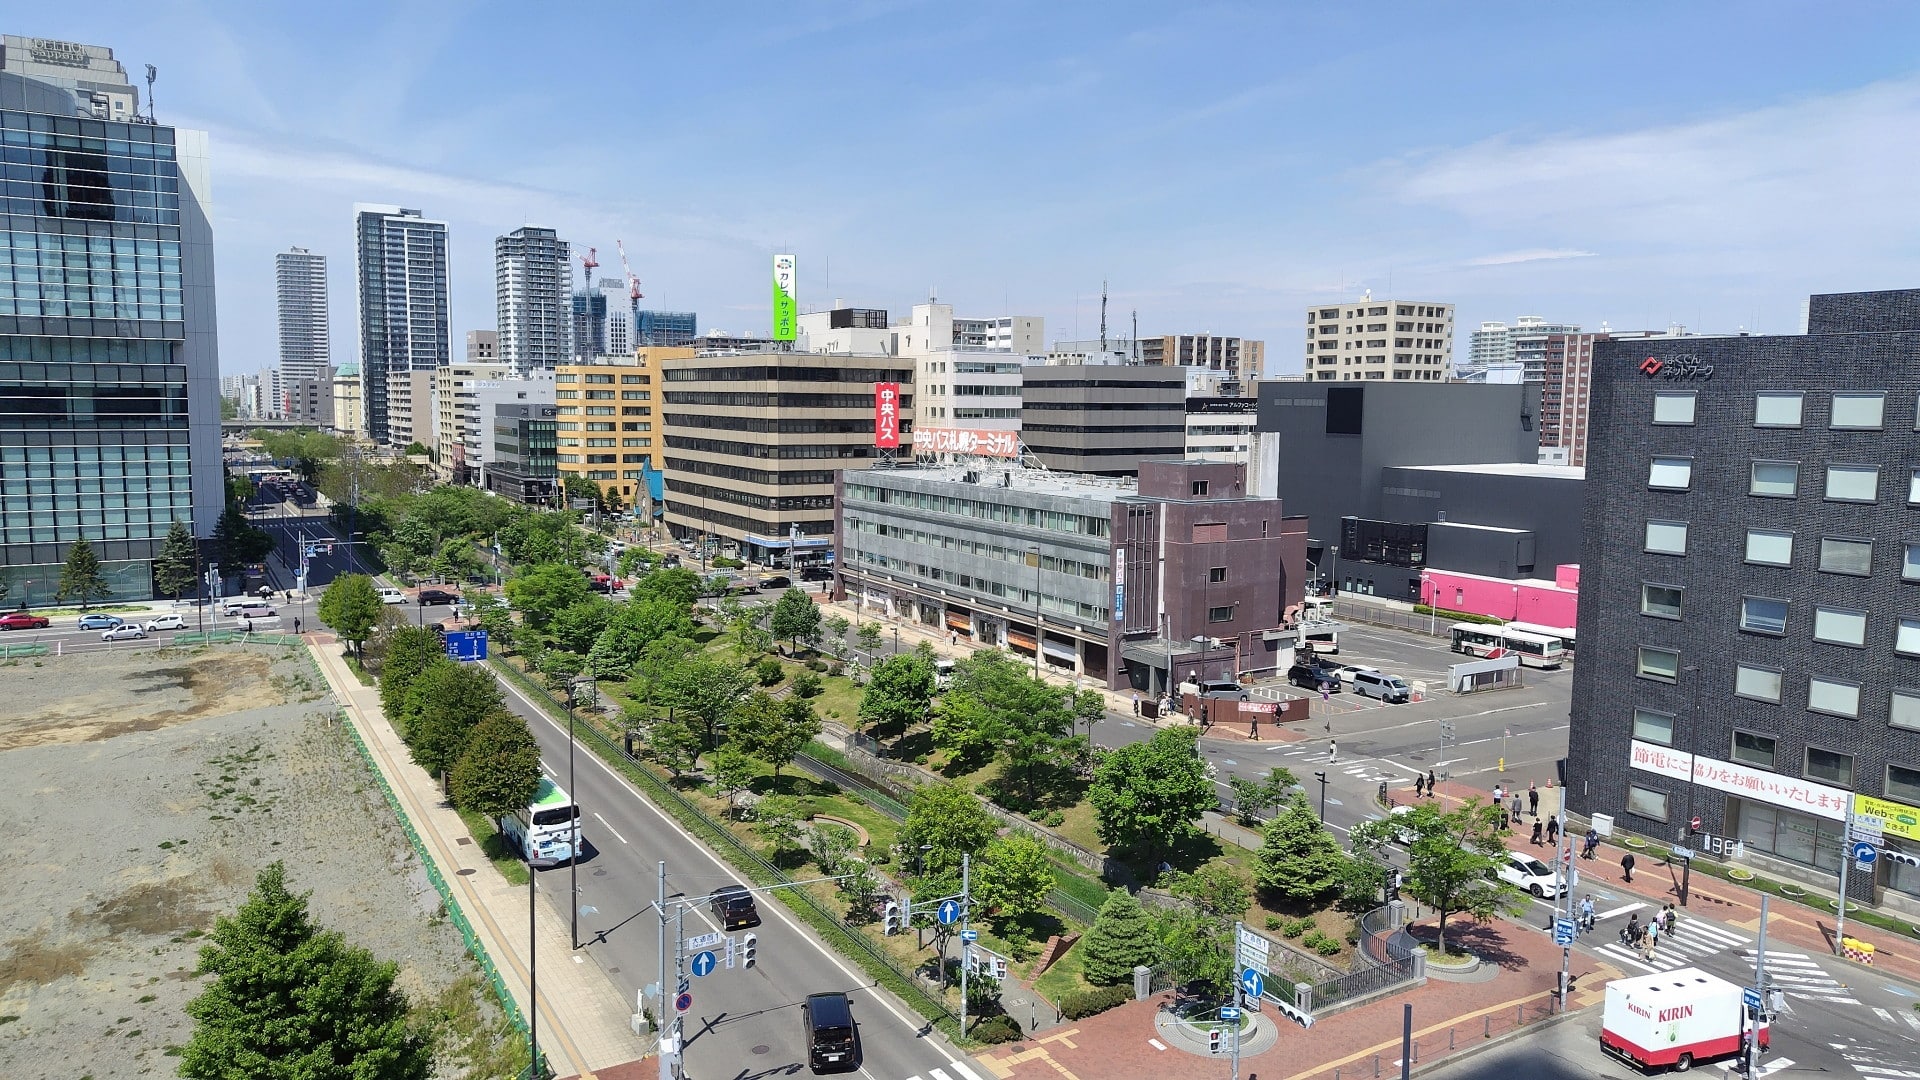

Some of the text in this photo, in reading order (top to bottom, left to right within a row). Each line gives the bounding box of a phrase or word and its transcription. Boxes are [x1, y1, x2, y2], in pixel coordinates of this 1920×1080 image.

[1663, 354, 1701, 365] ほくでん
[1663, 364, 1713, 376] ネットワーク
[880, 388, 894, 440] 中央バス
[913, 429, 1015, 454] 中央バス札幌ターミナル
[1864, 805, 1895, 820] Webで
[1627, 1002, 1651, 1019] KIRIN
[1658, 1004, 1694, 1023] KIRIN
